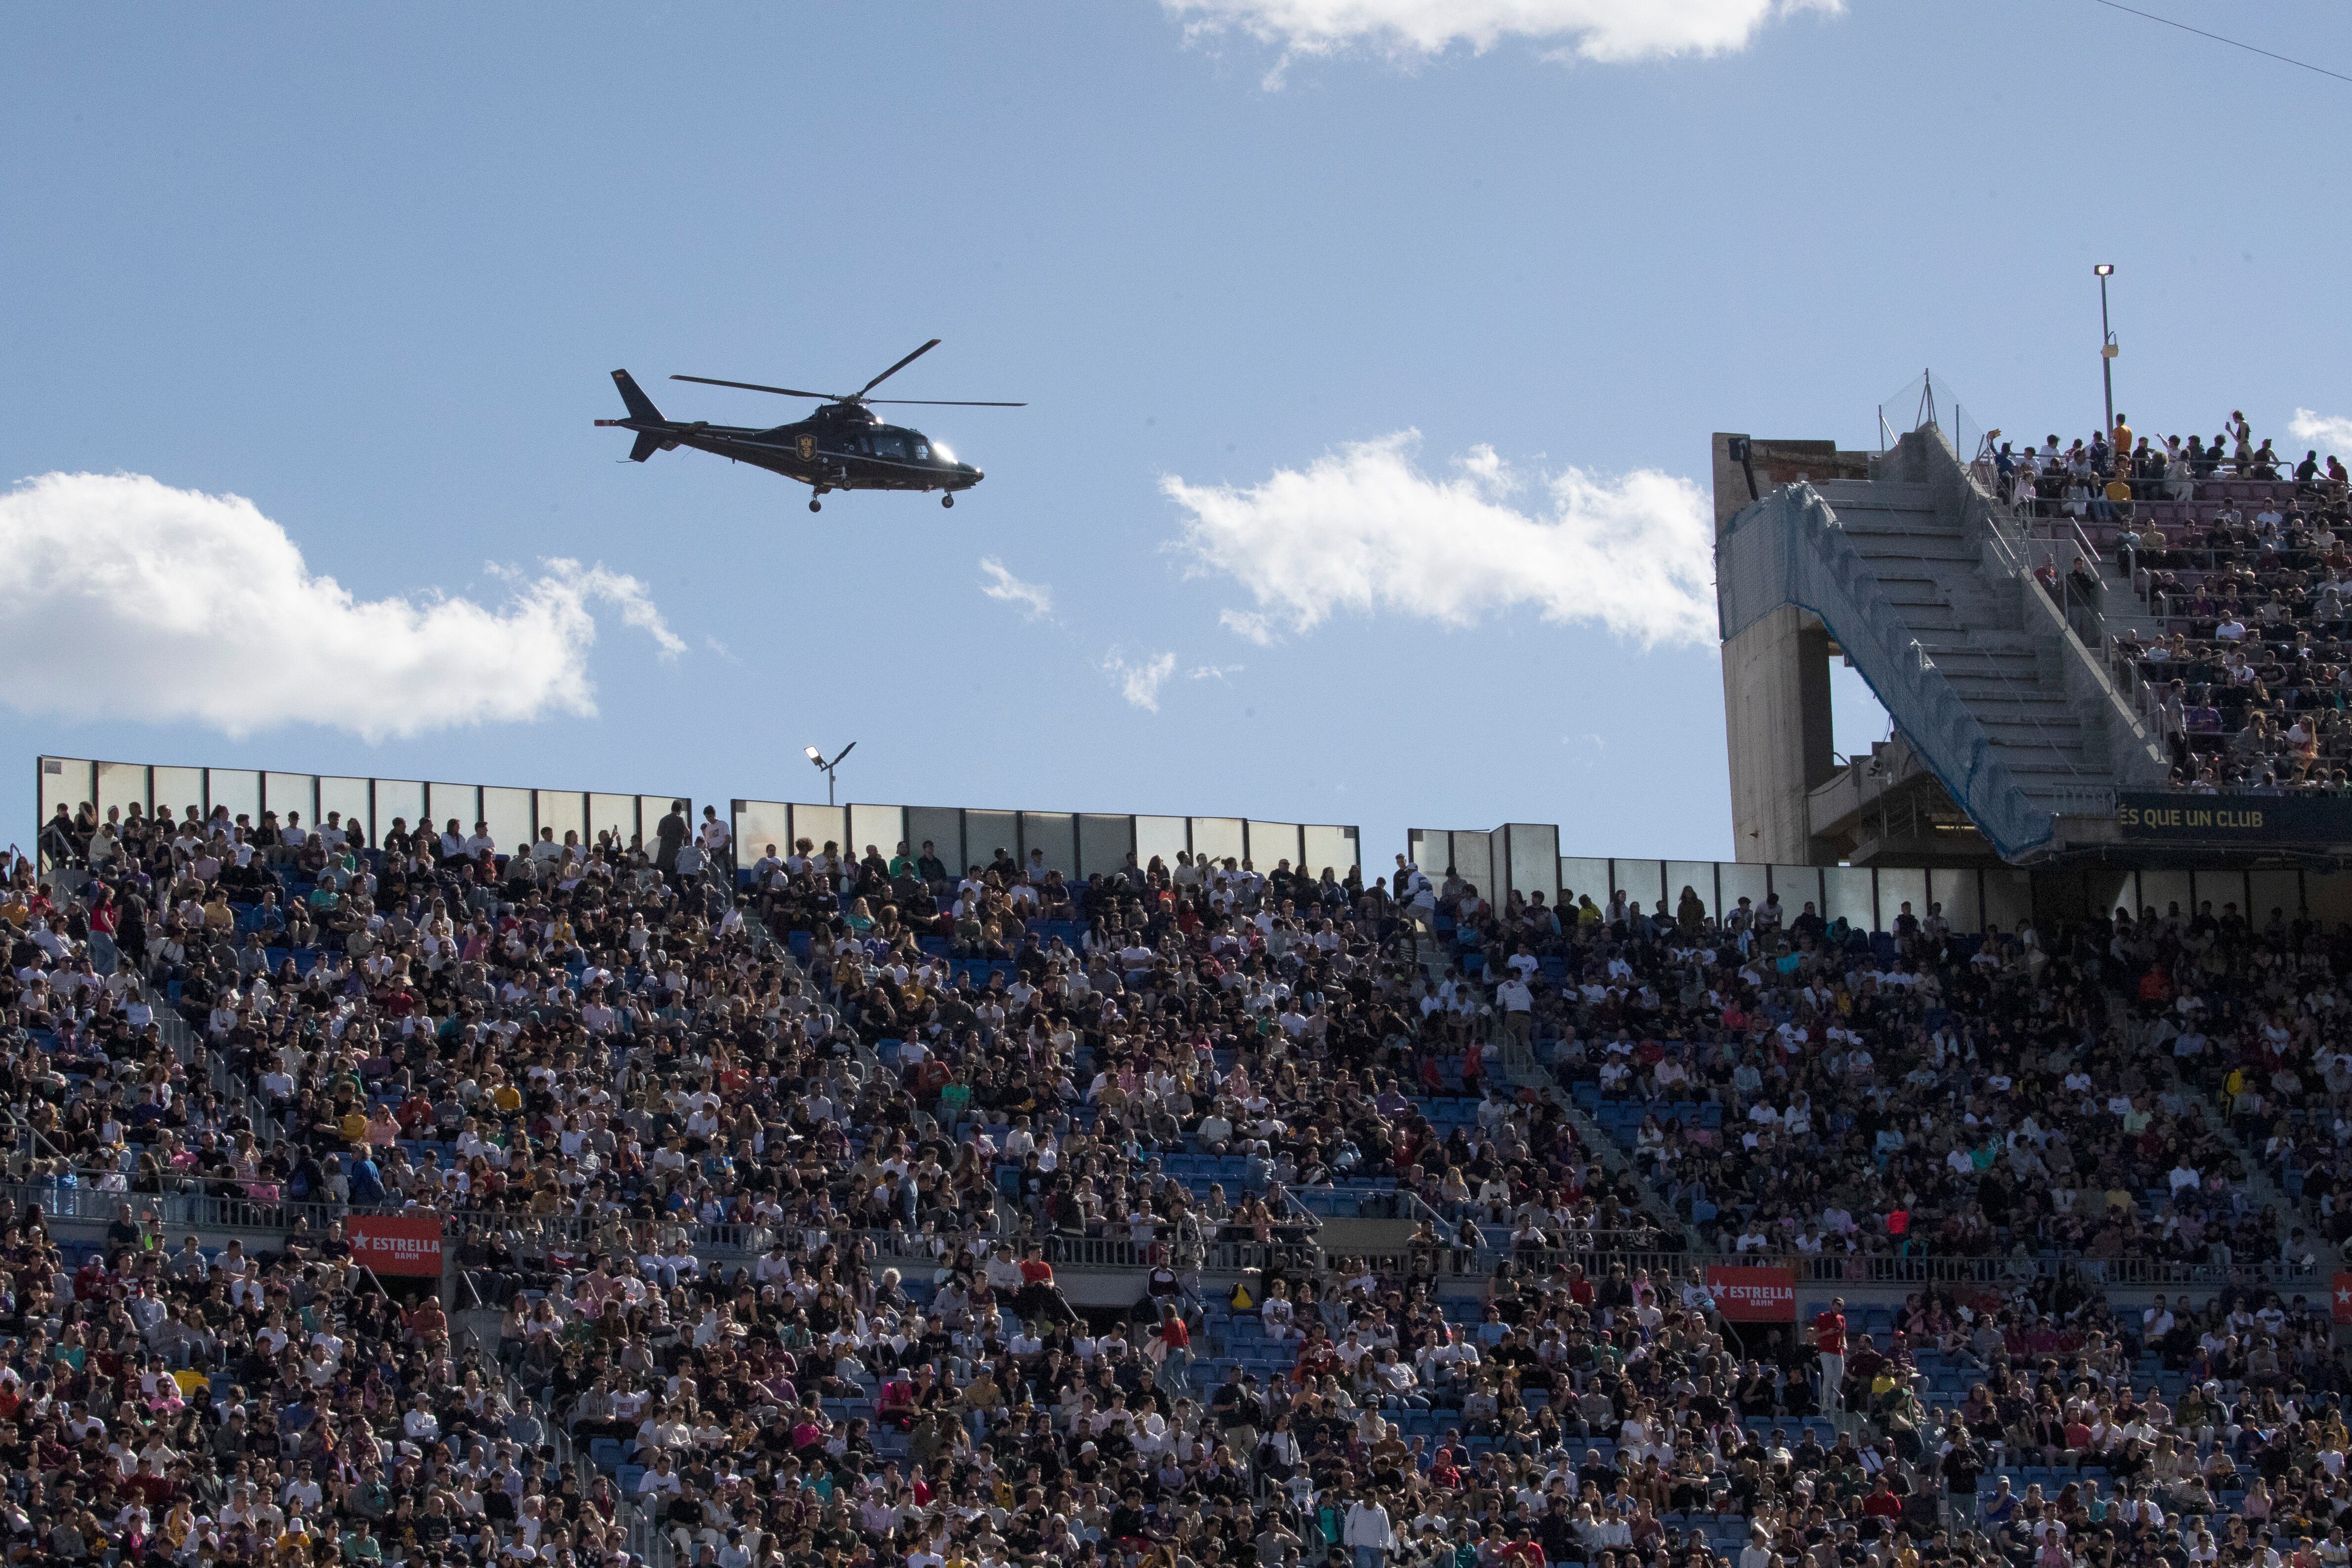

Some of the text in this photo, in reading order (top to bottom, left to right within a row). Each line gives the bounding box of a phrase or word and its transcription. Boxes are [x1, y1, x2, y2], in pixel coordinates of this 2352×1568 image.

[2144, 809, 2181, 829] QUE
[2185, 810, 2211, 826] UN
[2217, 810, 2263, 827] CLUB
[373, 1237, 440, 1253] ESTRELLA
[1731, 1286, 1793, 1299] ESTRELLA
